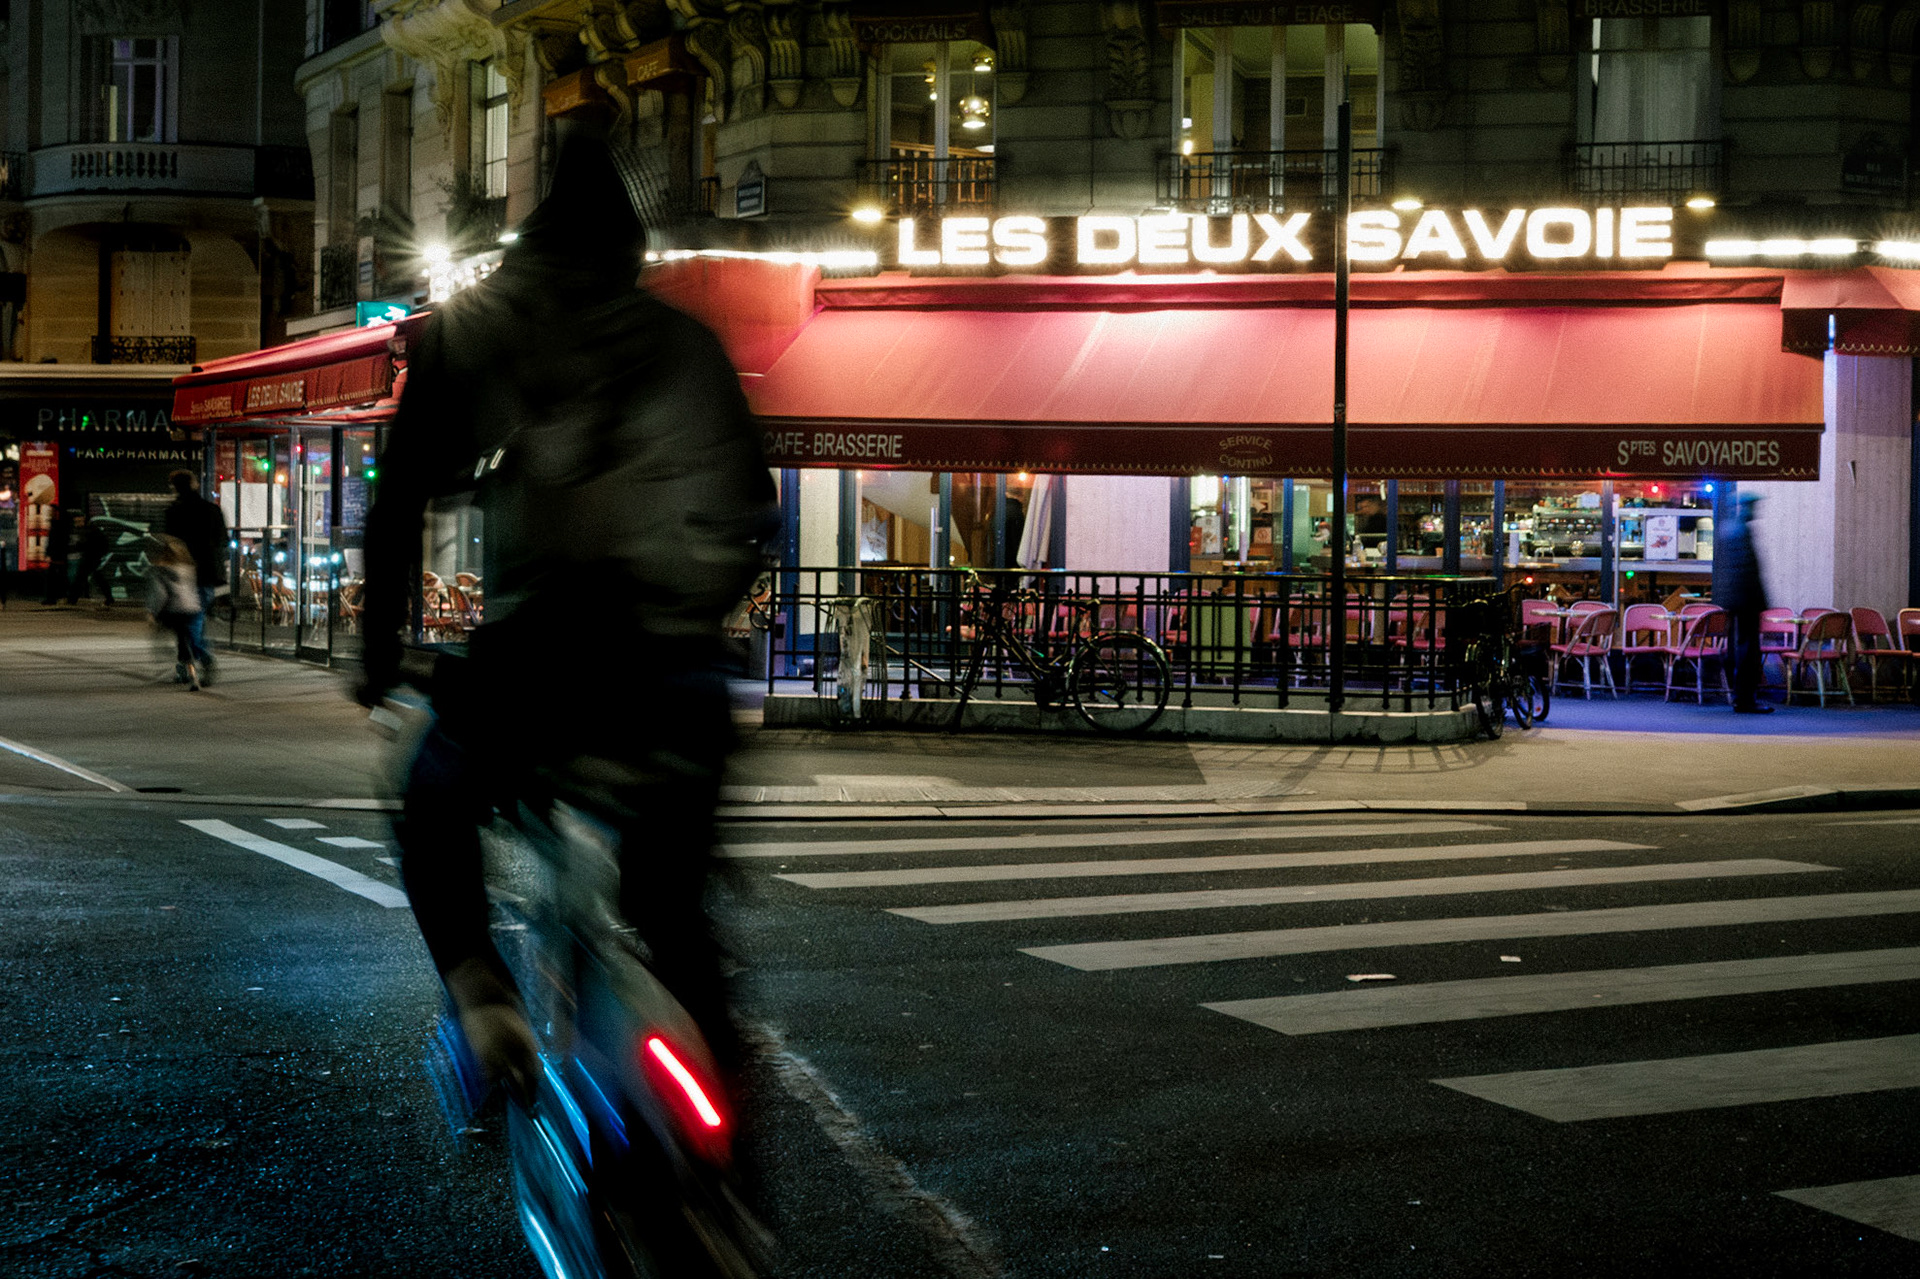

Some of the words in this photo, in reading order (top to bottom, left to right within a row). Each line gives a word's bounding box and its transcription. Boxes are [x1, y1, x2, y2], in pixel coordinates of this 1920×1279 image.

[860, 23, 967, 42] COCKTAILS
[898, 215, 1048, 266] LES
[1076, 212, 1313, 265] DEUX
[1346, 205, 1674, 262] SAVOIE
[1218, 435, 1273, 450] SERVICE
[1218, 453, 1273, 469] CONTINU
[1662, 439, 1780, 467] SAVOYARDES
